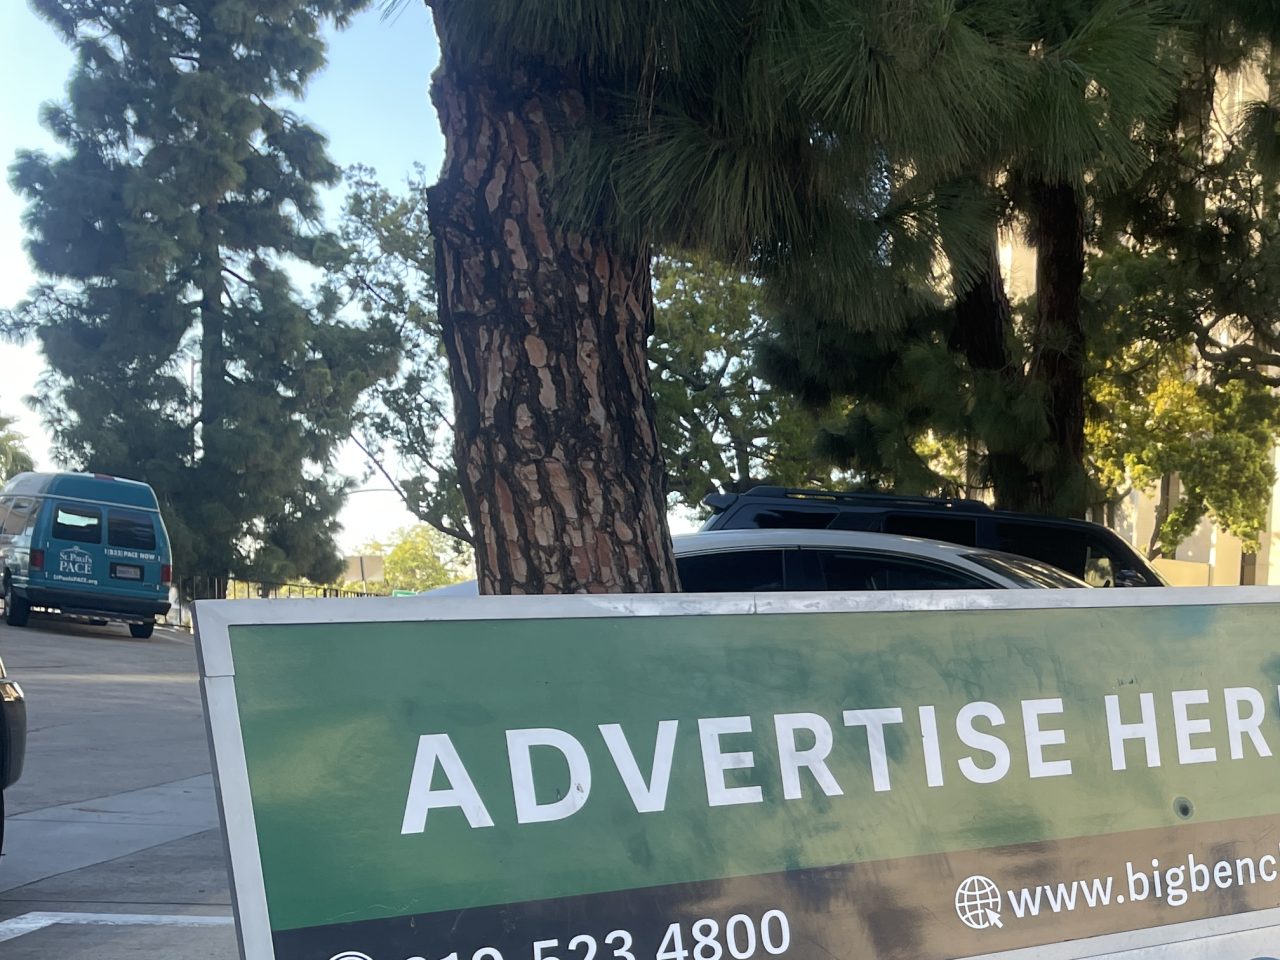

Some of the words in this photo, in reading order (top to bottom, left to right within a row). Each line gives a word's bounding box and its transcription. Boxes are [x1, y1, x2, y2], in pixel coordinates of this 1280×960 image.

[124, 551, 138, 559] PACE
[140, 553, 156, 561] NOW
[60, 561, 92, 575] PACE
[401, 698, 1073, 834] ADVERTISE
